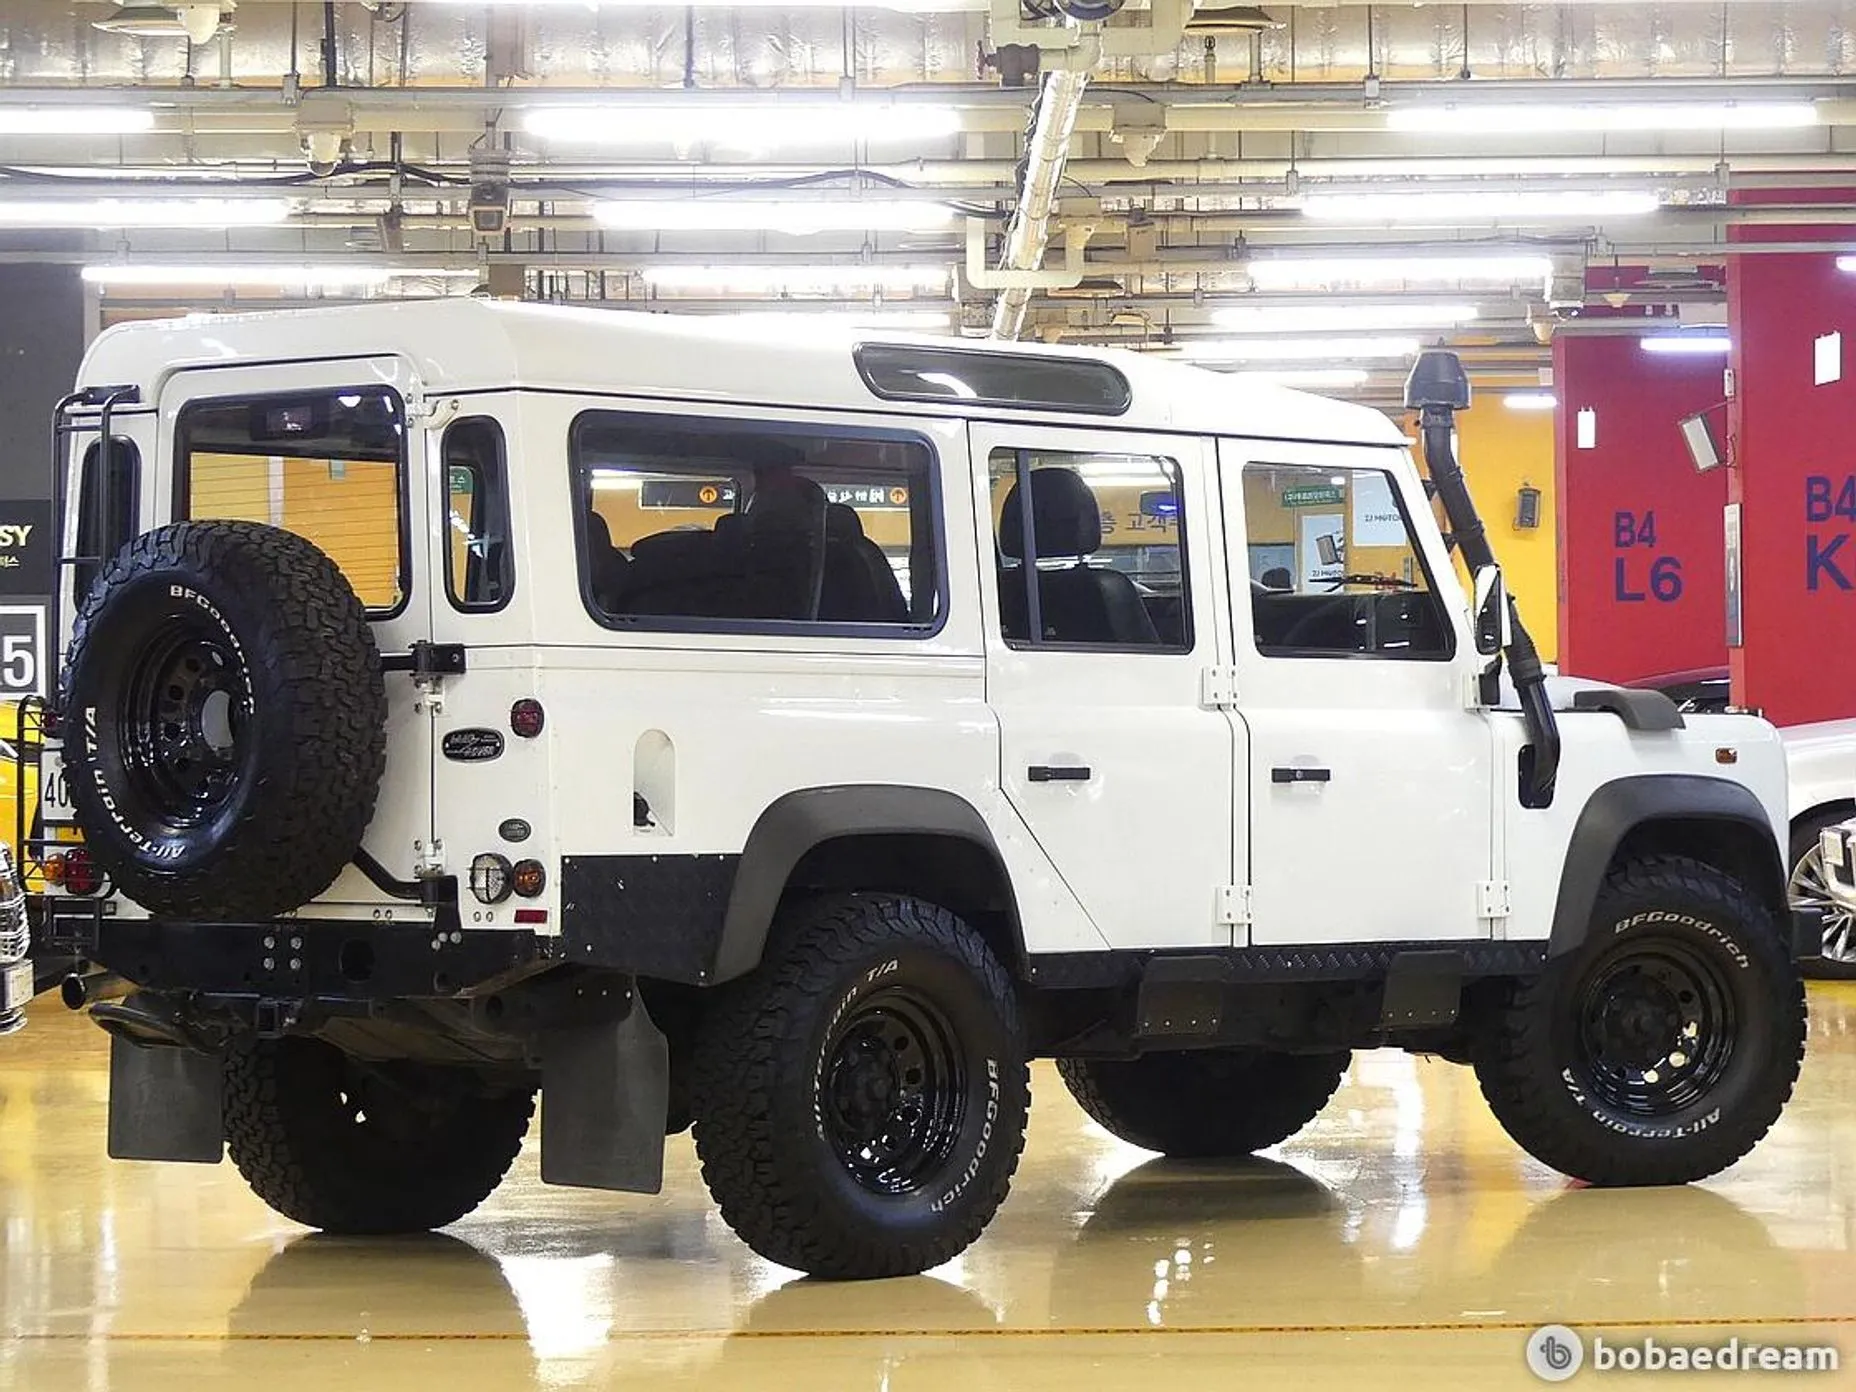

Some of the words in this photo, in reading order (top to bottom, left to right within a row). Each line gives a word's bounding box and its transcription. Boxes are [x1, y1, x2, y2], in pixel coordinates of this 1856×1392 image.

[1806, 475, 1856, 522] B4
[1615, 511, 1656, 548] B4
[1615, 556, 1682, 602] L6
[0, 635, 35, 687] 5
[1615, 911, 1750, 969] BFGoodrich
[866, 959, 898, 982] T/A
[1562, 1067, 1586, 1106] T/A
[930, 1058, 999, 1213] BFGoodrich
[1592, 1107, 1721, 1139] All-Terrain
